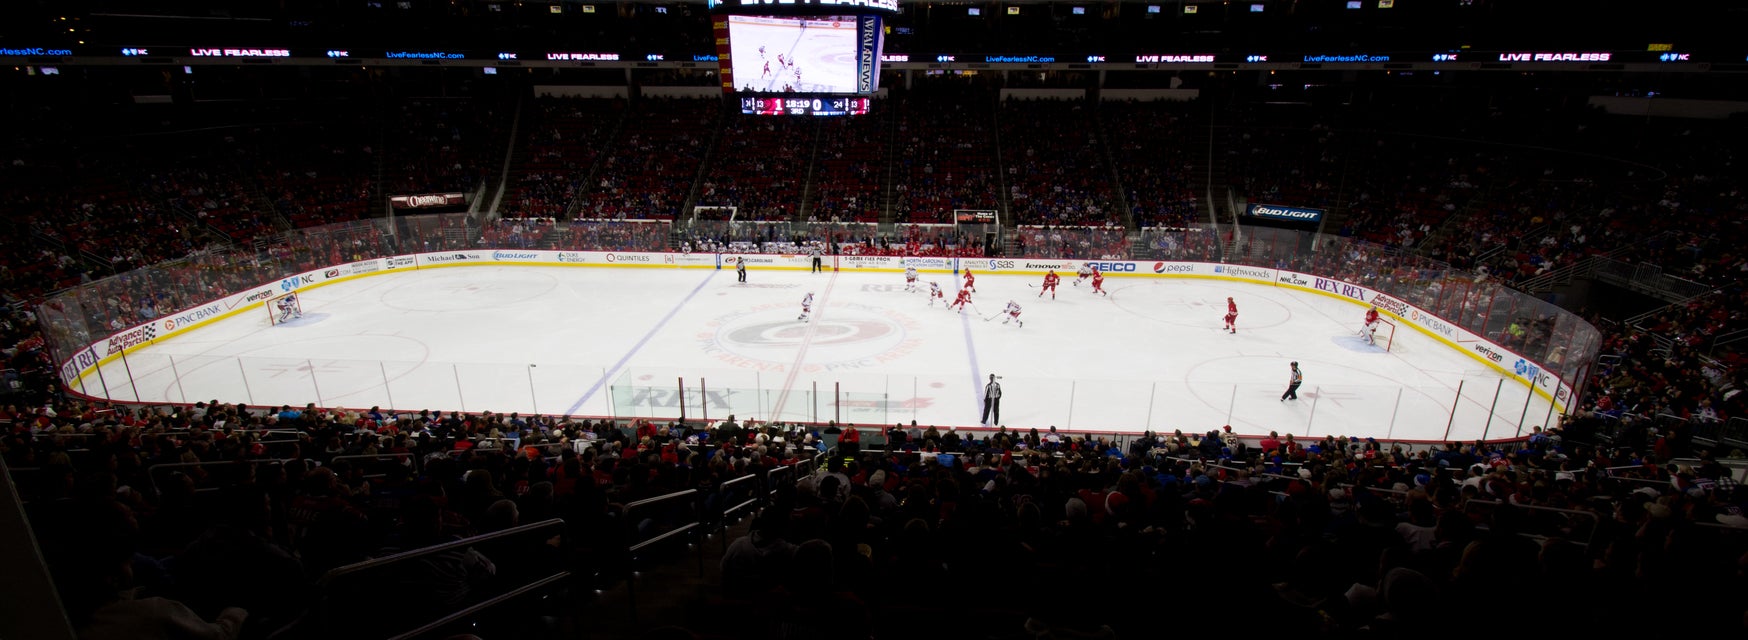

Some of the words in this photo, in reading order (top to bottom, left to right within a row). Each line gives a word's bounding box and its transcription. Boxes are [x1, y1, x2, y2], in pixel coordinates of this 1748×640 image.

[191, 49, 222, 57] LIVE
[224, 49, 290, 57] FEARLESS
[386, 51, 464, 59] LiveFearlessNC.com
[986, 55, 1055, 63] LiveFearlessNC.com
[1304, 54, 1390, 62] LiveFearlessNC.com
[1499, 53, 1530, 61] LIVE
[1533, 53, 1611, 61] FEARLESS
[862, 53, 871, 91] NEWS
[775, 99, 782, 111] 1
[786, 100, 810, 108] 18:19
[812, 99, 822, 111] 0
[834, 101, 843, 109] 24
[1257, 207, 1282, 216] BUD
[1282, 210, 1318, 219] LIGHT
[427, 254, 454, 262] Michael
[1088, 262, 1136, 272] GEICO
[1166, 264, 1194, 274] pepsi
[1222, 265, 1270, 279] Highwoods
[301, 274, 313, 285] NC
[1280, 276, 1307, 286] NHL.COM
[246, 288, 272, 303] verizon
[1314, 278, 1340, 293] REX
[1342, 284, 1367, 301] REX
[1376, 293, 1401, 308] Advance
[108, 329, 142, 347] Advance
[107, 345, 121, 356] Auto
[123, 337, 143, 349] Parts
[1475, 342, 1503, 363] verizon
[1537, 373, 1550, 388] NC
[626, 388, 740, 409] REX
